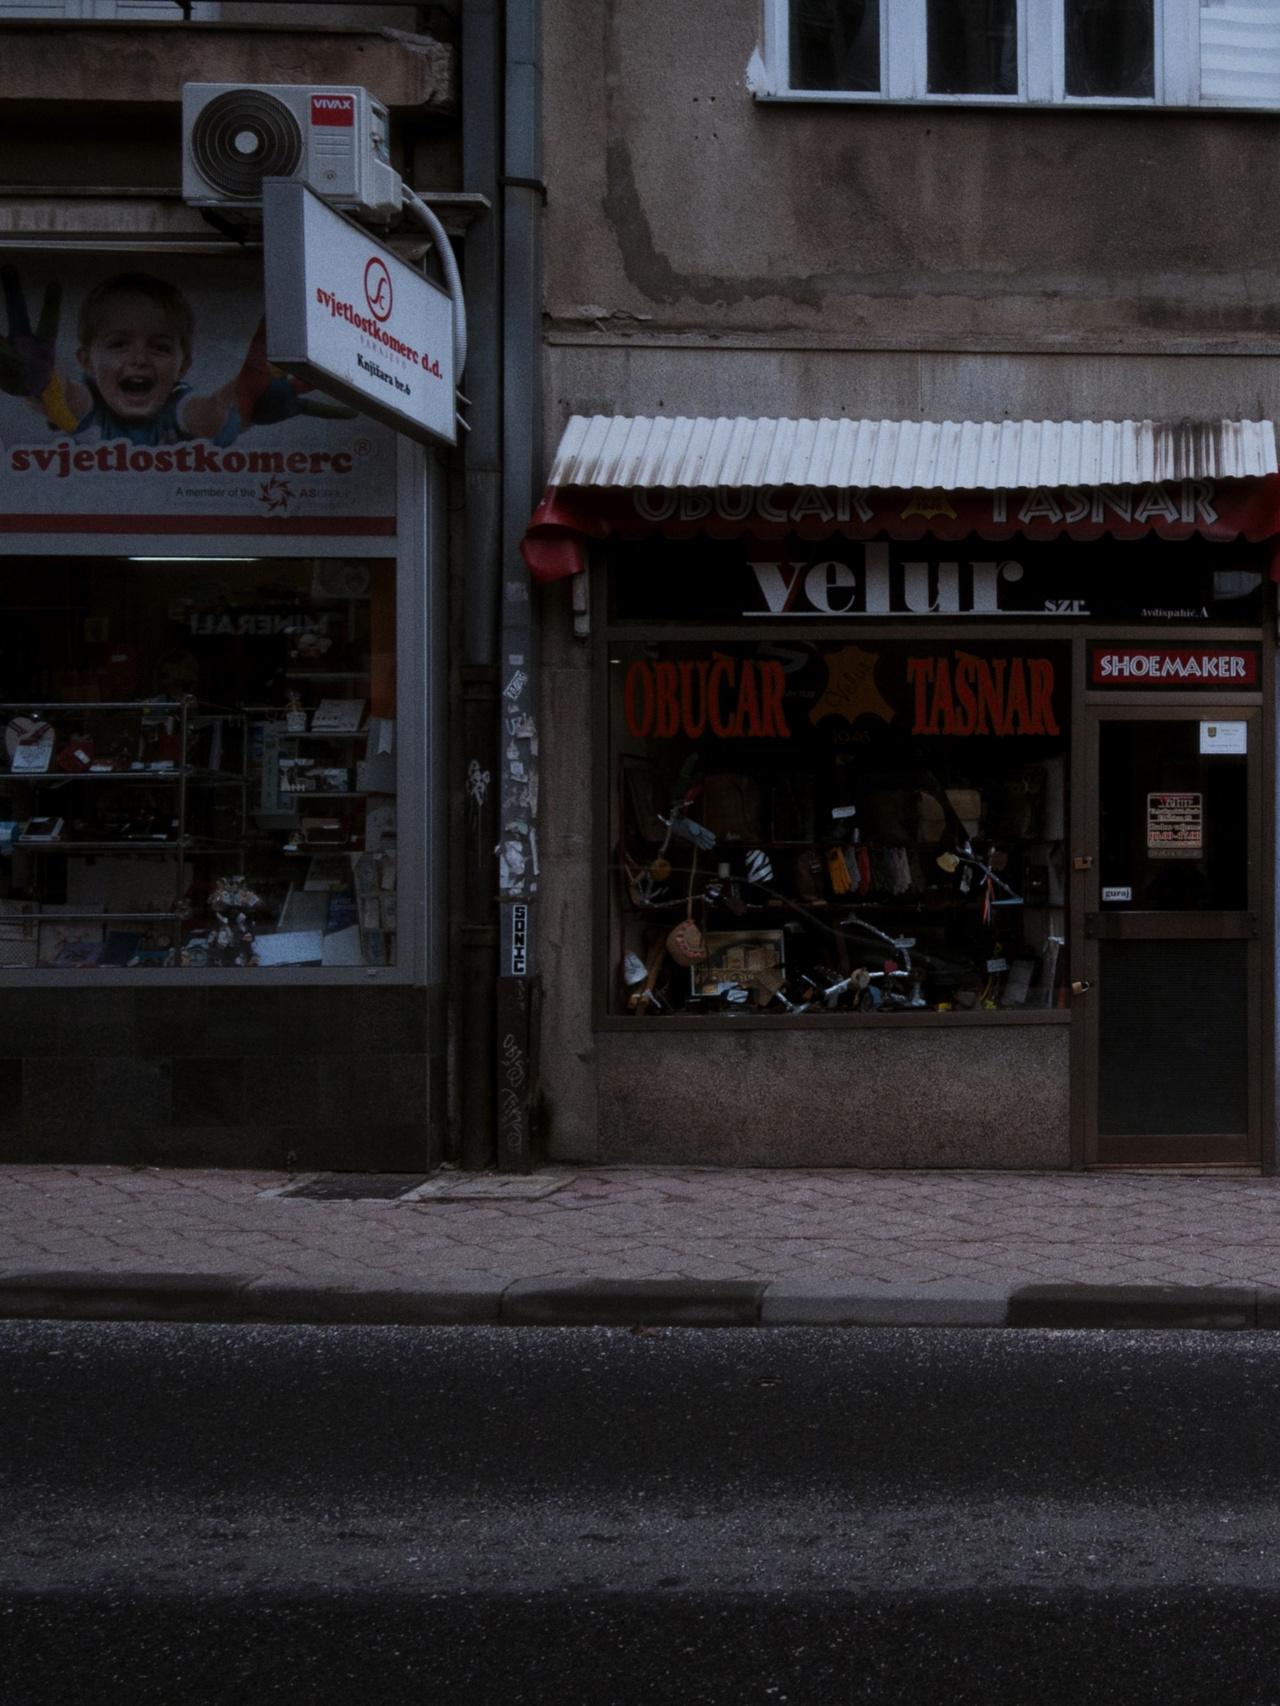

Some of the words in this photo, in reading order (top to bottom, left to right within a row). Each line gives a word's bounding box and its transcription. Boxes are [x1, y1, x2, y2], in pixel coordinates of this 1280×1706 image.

[313, 99, 351, 109] VIVAX
[316, 287, 419, 365] svjetlostkomerc
[421, 353, 443, 379] d.d.
[356, 352, 394, 386] Knjižara
[11, 442, 353, 478] svjetlostkomerc
[186, 487, 225, 497] member
[228, 487, 238, 497] of
[240, 487, 256, 497] the
[1100, 654, 1247, 678] SHOEMAKER
[1105, 889, 1130, 899] guraj
[514, 906, 526, 973] SONIC
